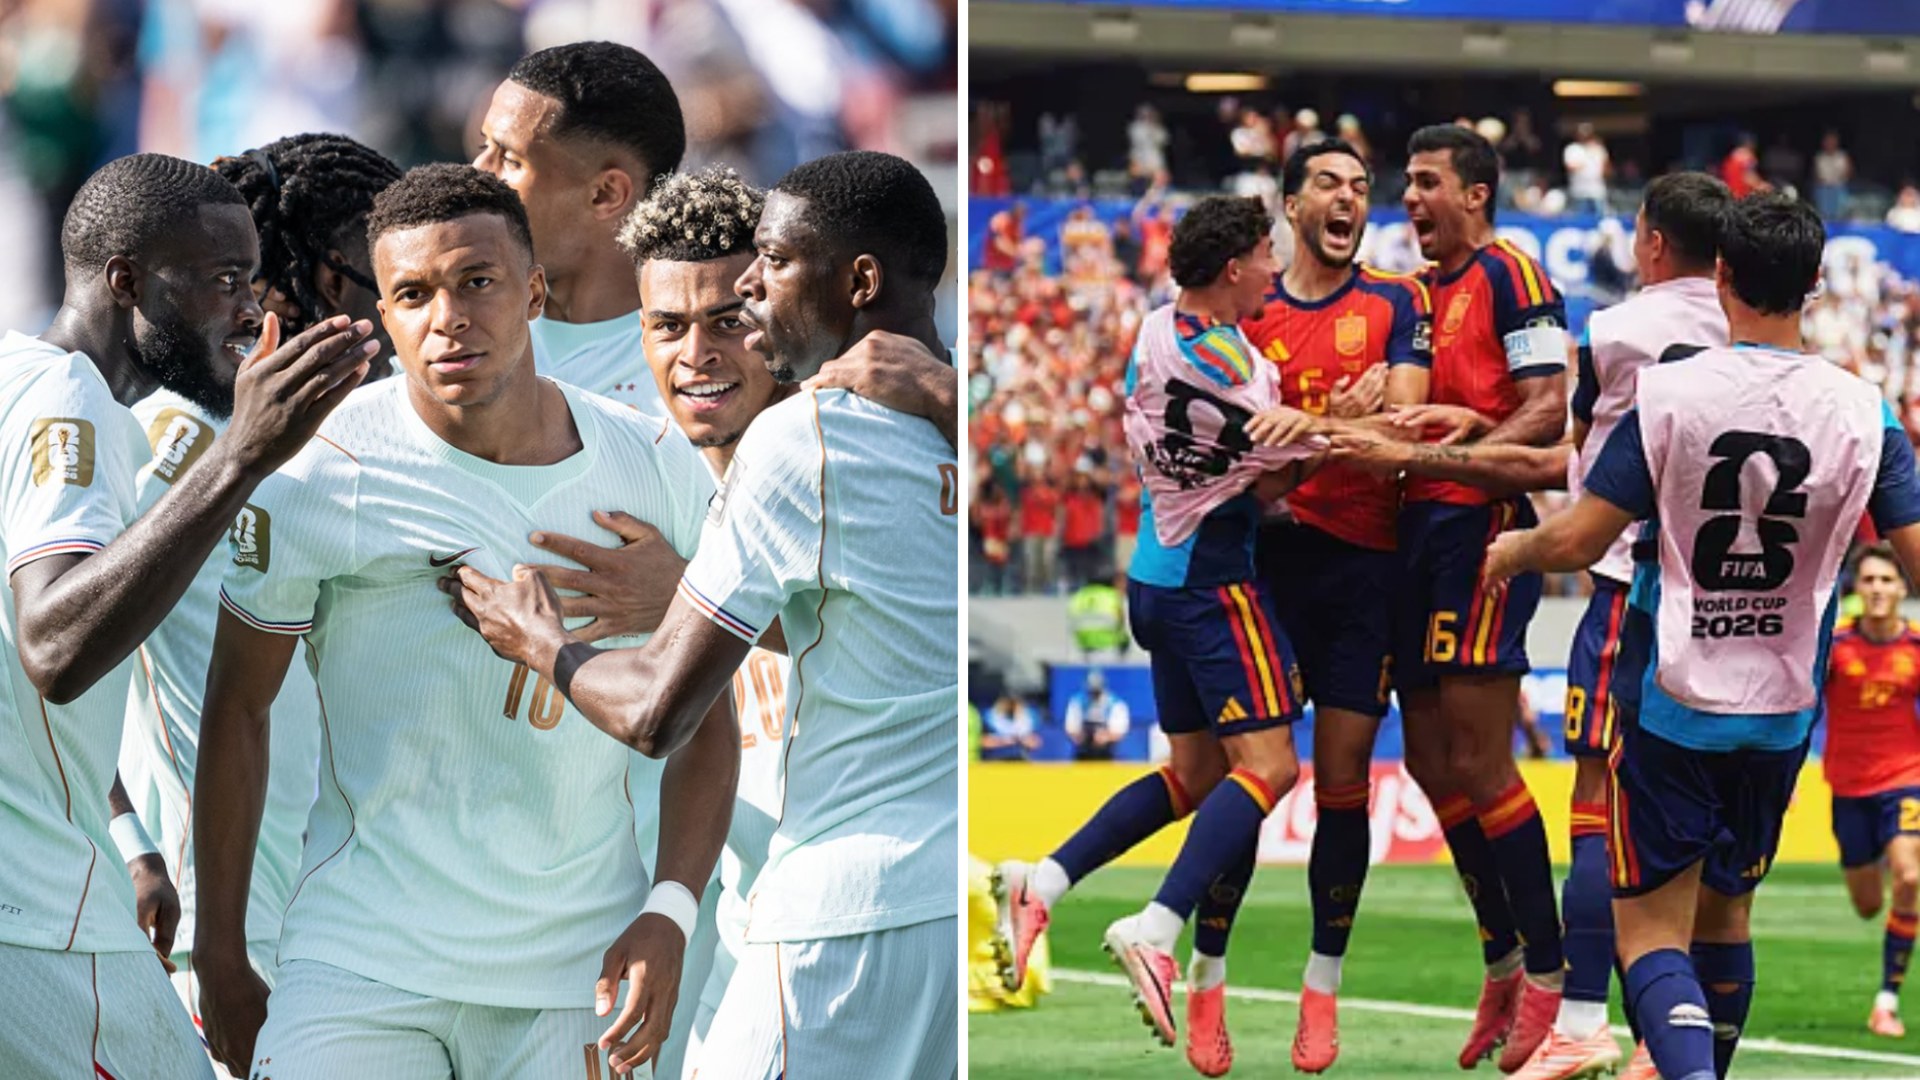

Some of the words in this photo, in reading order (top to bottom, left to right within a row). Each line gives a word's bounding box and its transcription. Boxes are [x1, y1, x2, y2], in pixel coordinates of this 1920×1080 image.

[1719, 560, 1768, 579] FIFA
[1751, 597, 1788, 611] CUP
[1691, 613, 1784, 640] 2026
[1899, 796, 1920, 832] 2
